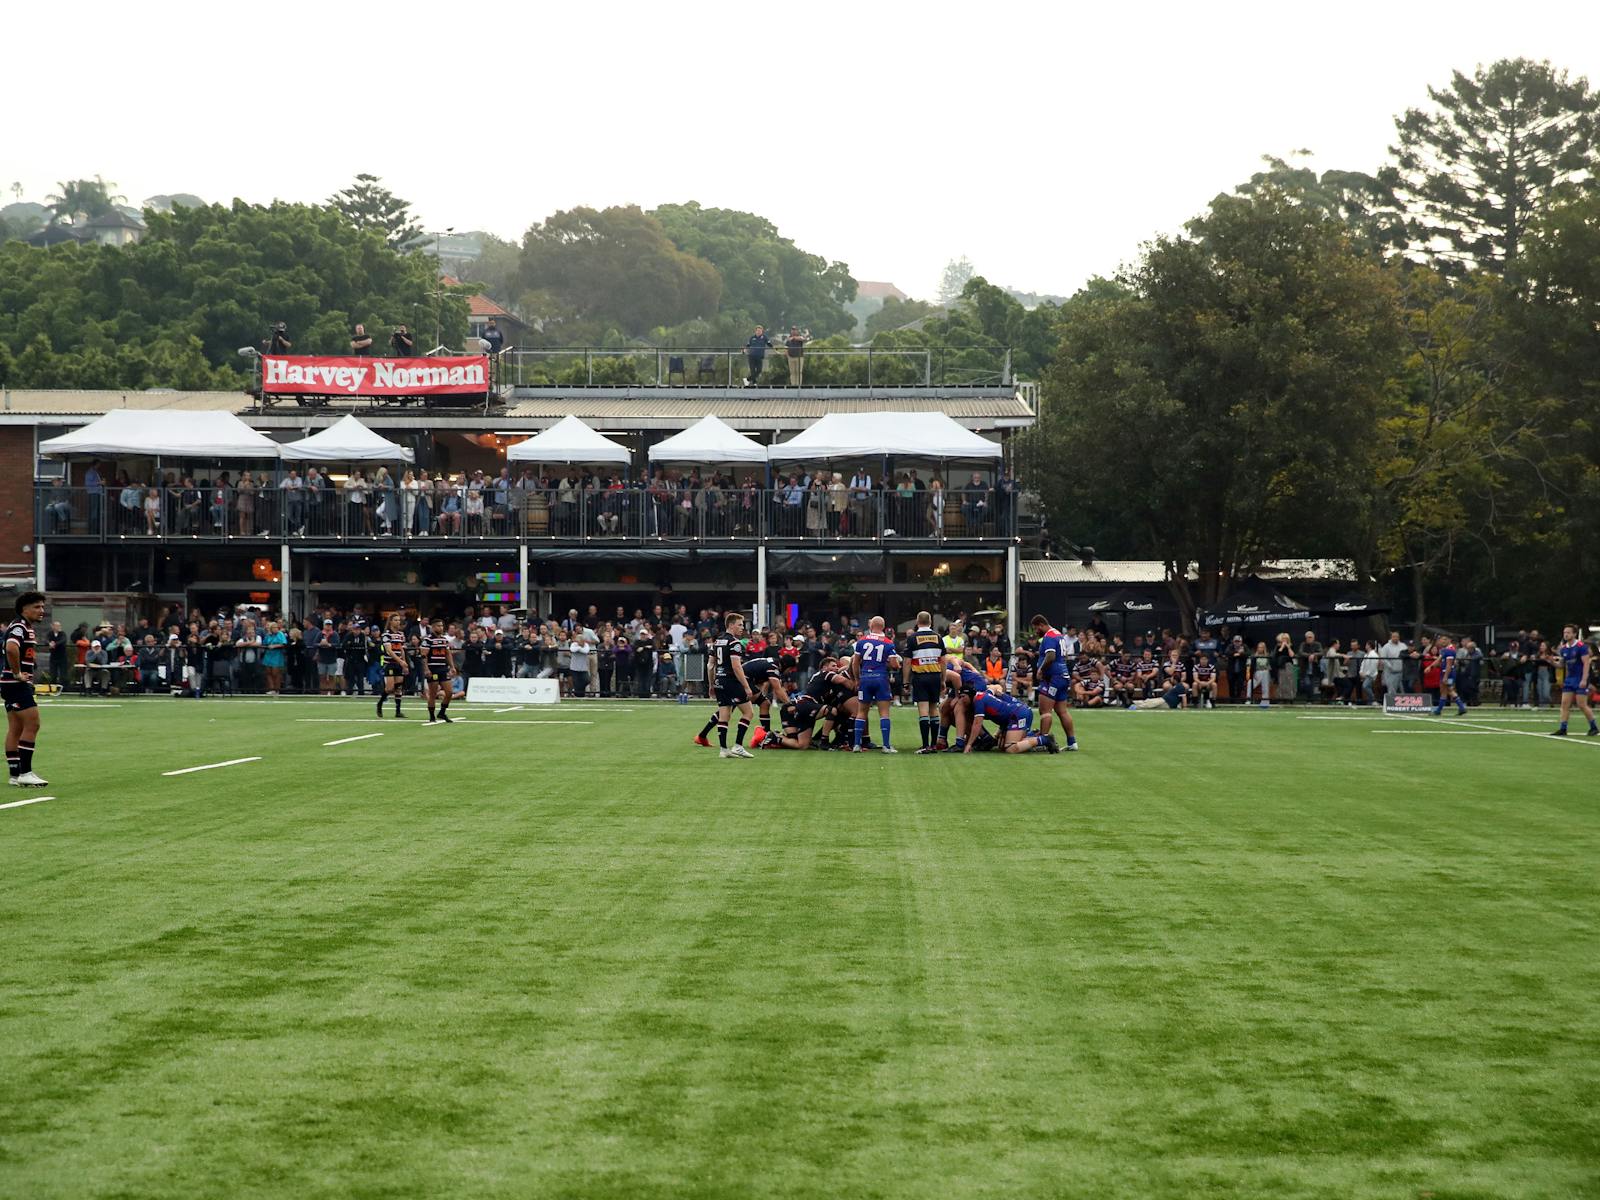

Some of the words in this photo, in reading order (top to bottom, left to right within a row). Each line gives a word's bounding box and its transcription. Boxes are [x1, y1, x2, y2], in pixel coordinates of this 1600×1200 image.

[265, 359, 369, 392] Harvey
[373, 362, 485, 388] Norman
[1249, 614, 1266, 622] MADE
[716, 647, 723, 665] 9
[862, 642, 885, 663] 21
